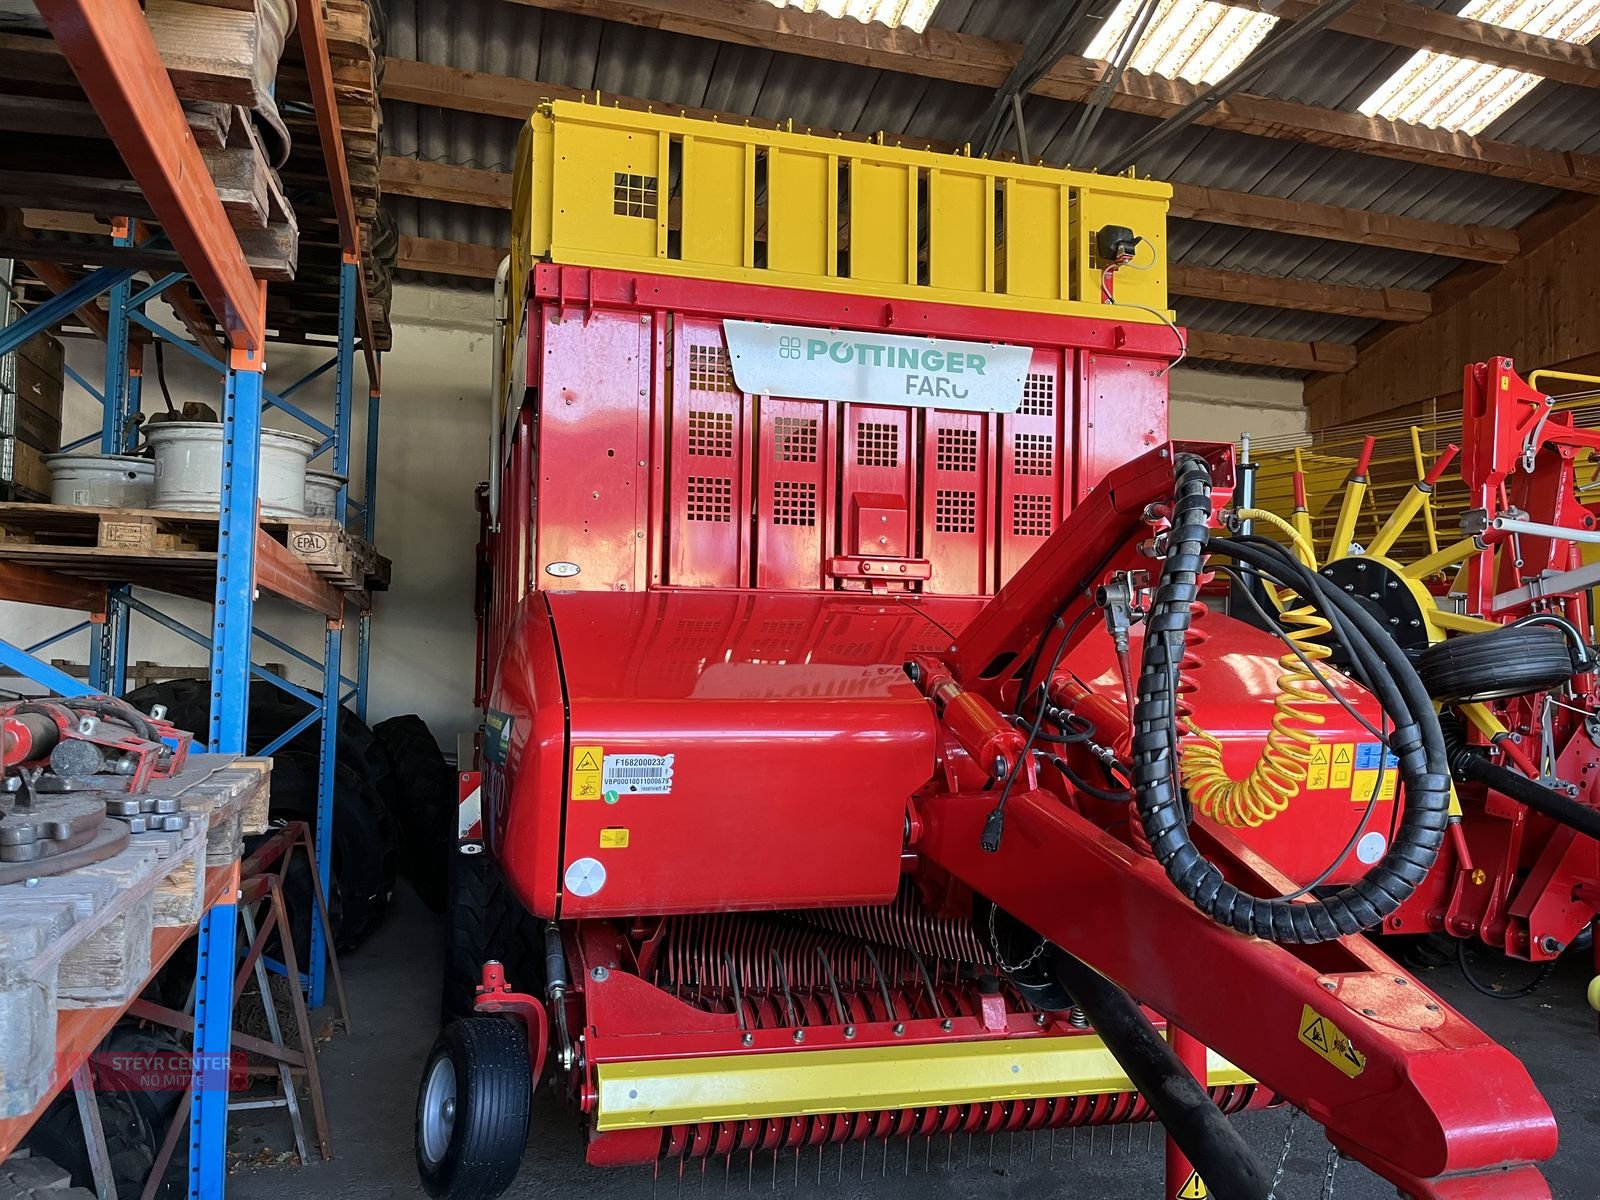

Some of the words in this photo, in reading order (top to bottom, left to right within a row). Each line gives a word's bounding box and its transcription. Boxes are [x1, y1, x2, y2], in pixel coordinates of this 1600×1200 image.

[807, 339, 986, 375] PÖTTINGER
[297, 538, 321, 548] EPAL
[615, 758, 665, 766] F1682000232
